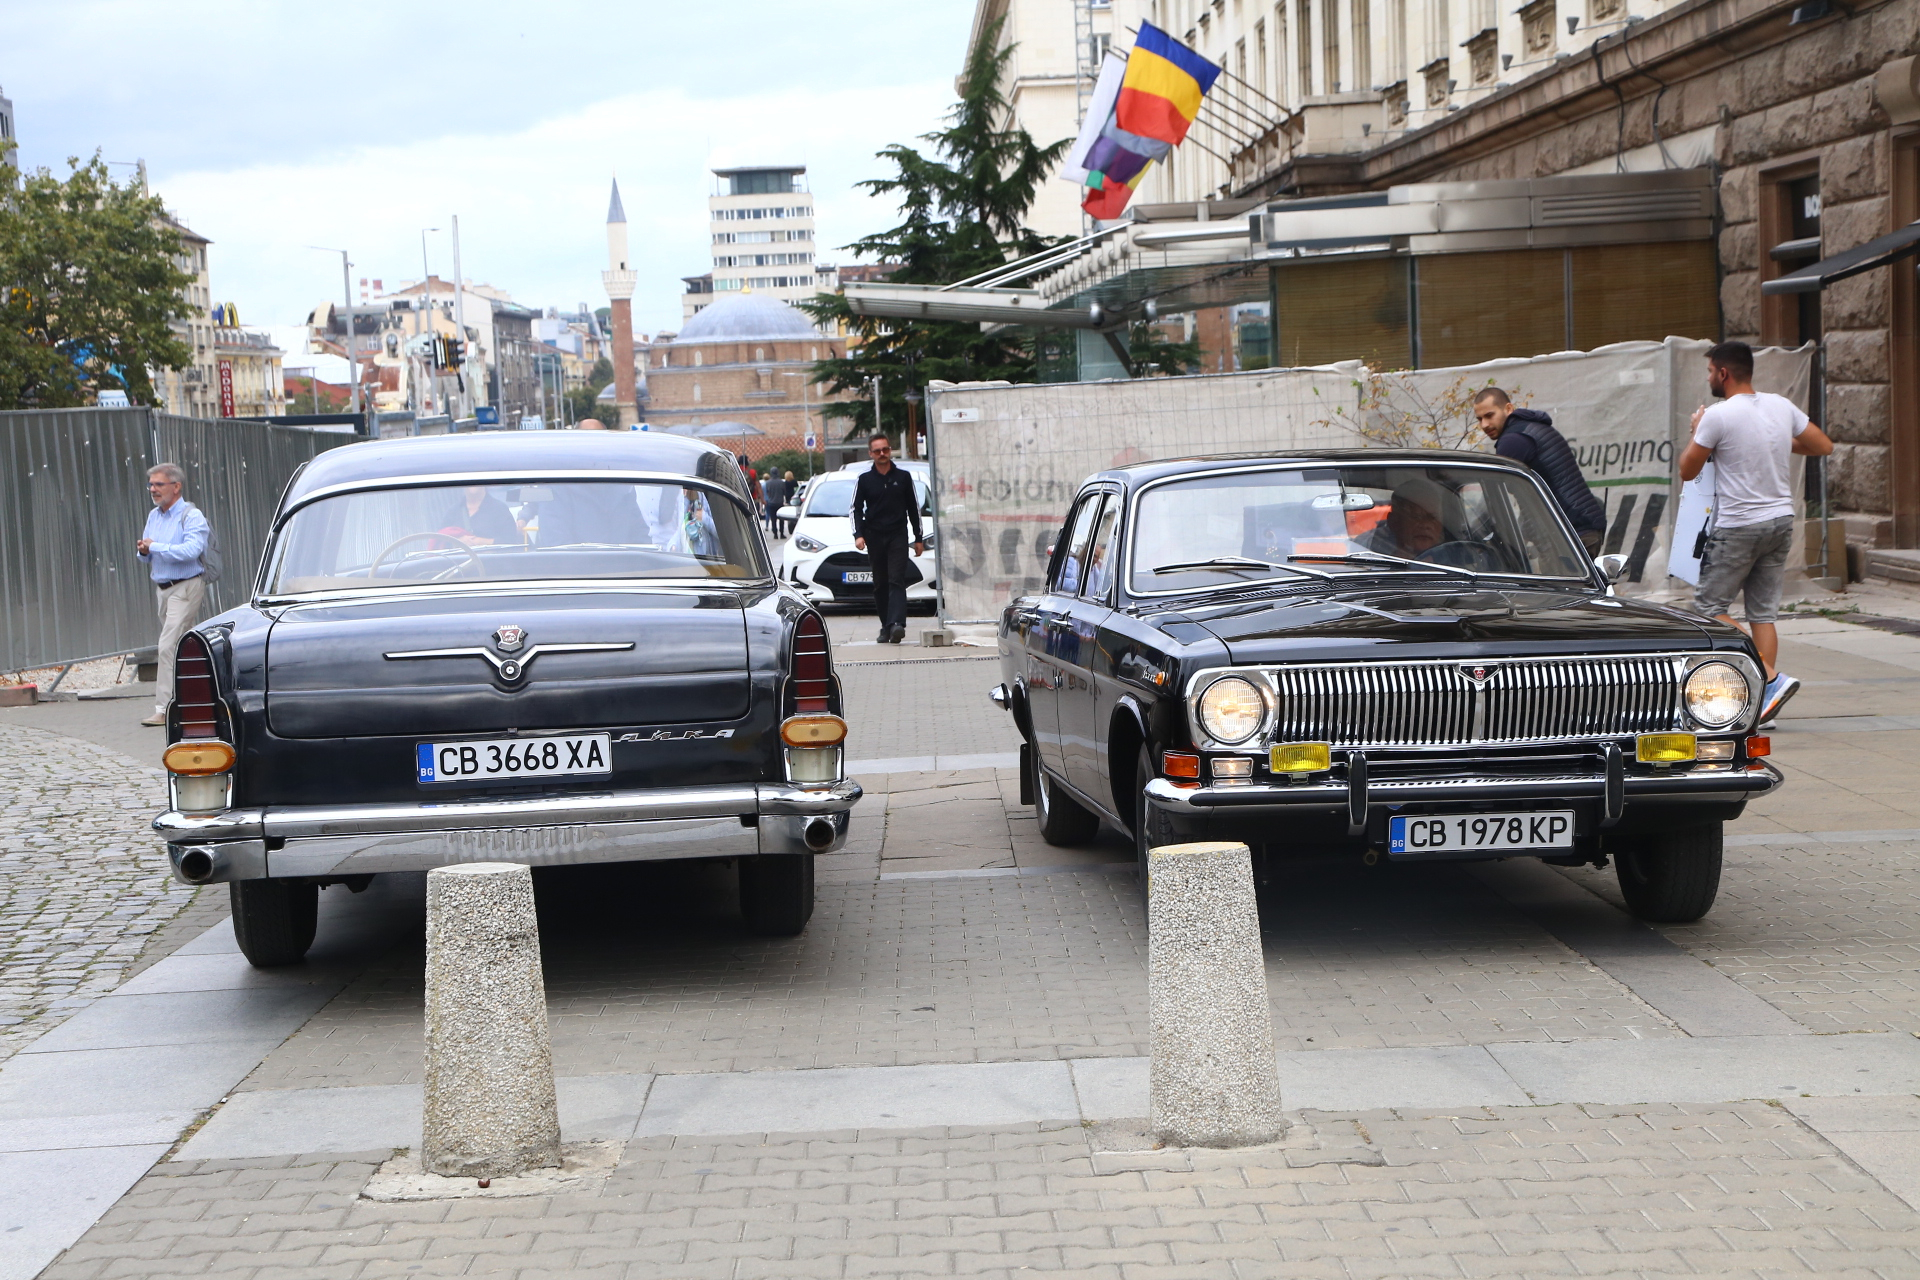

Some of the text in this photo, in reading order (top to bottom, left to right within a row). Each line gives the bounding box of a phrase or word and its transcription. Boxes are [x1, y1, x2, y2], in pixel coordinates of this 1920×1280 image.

[220, 361, 233, 418] McDonal
[420, 767, 433, 777] BG
[439, 739, 604, 776] CB 3668 XA
[1391, 839, 1404, 848] BG
[1410, 816, 1568, 847] CB 1978 KP
